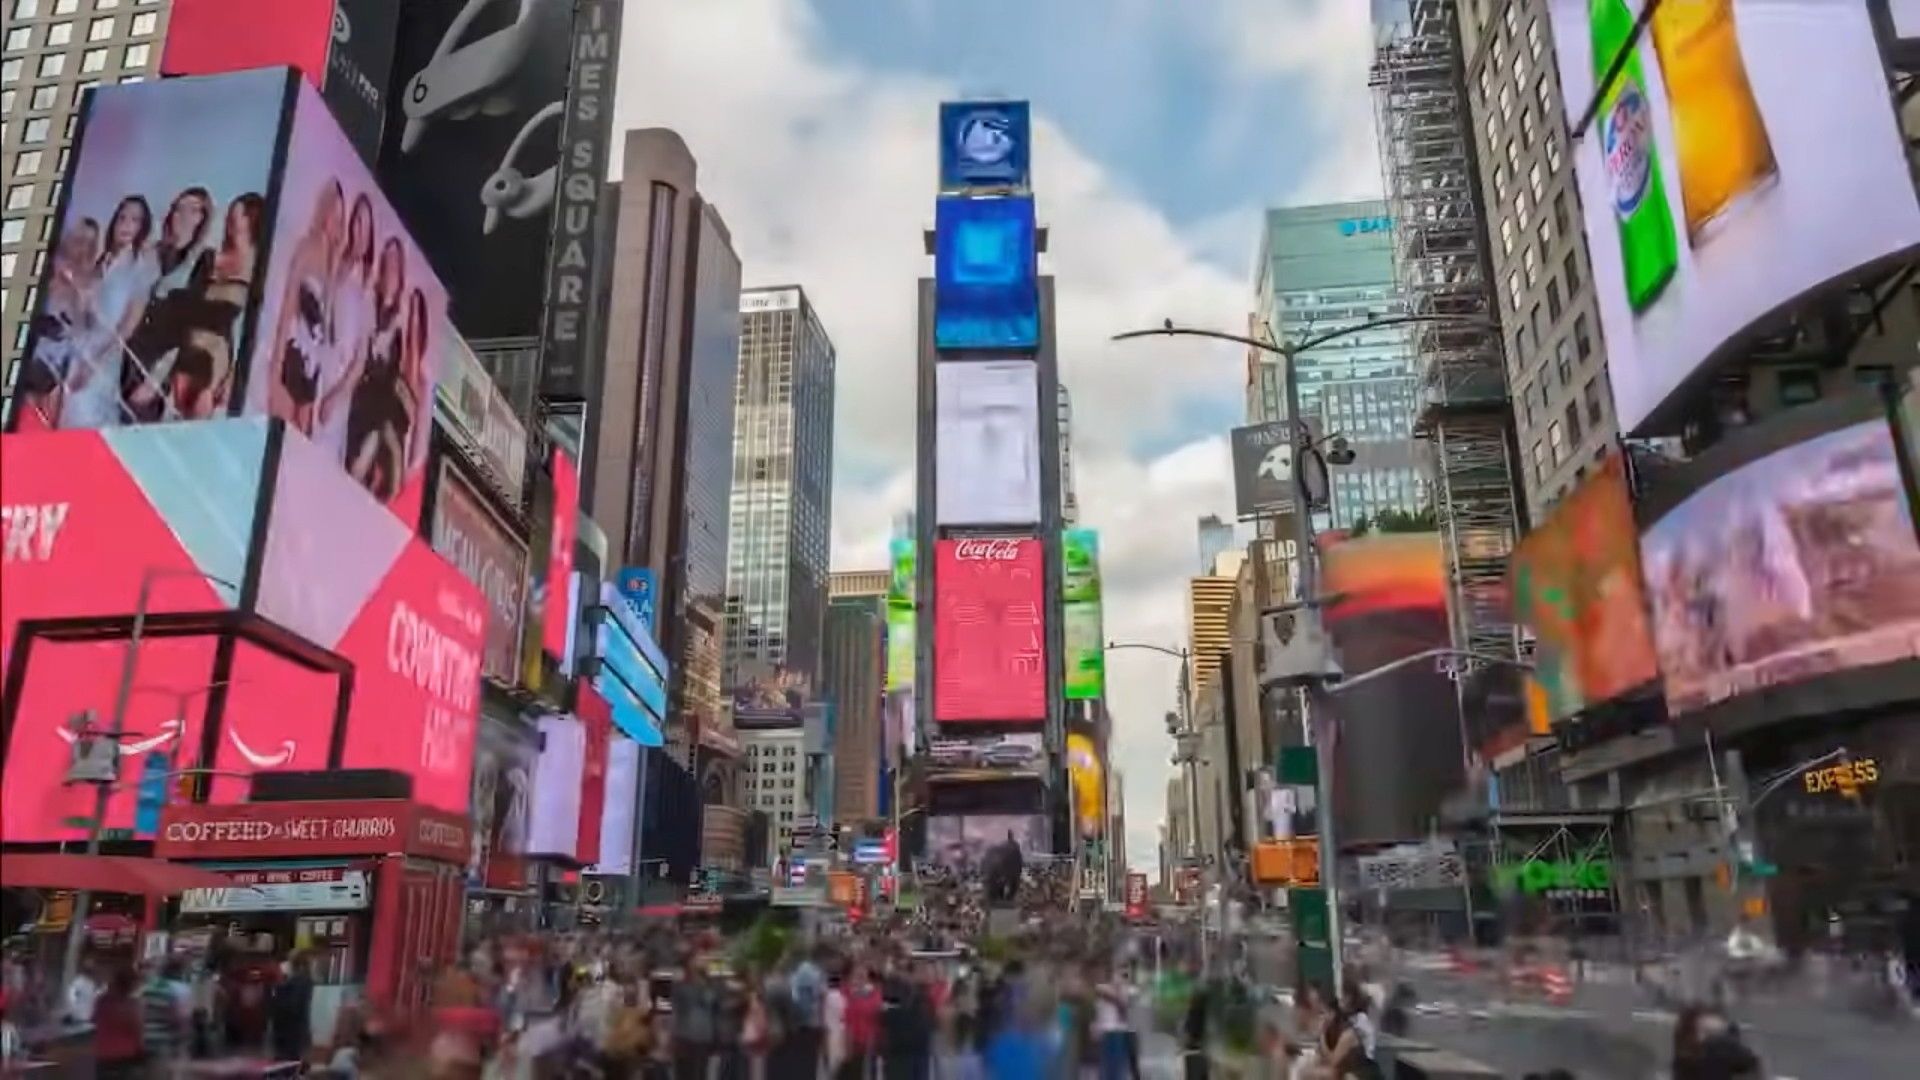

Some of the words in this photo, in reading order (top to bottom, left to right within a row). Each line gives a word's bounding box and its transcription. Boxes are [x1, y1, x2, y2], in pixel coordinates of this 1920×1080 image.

[553, 140, 596, 342] SQUARE
[1804, 758, 1879, 793] EXPSS
[167, 821, 273, 842] COFFEED
[285, 818, 328, 840] SWEET
[332, 816, 396, 839] CHURROS
